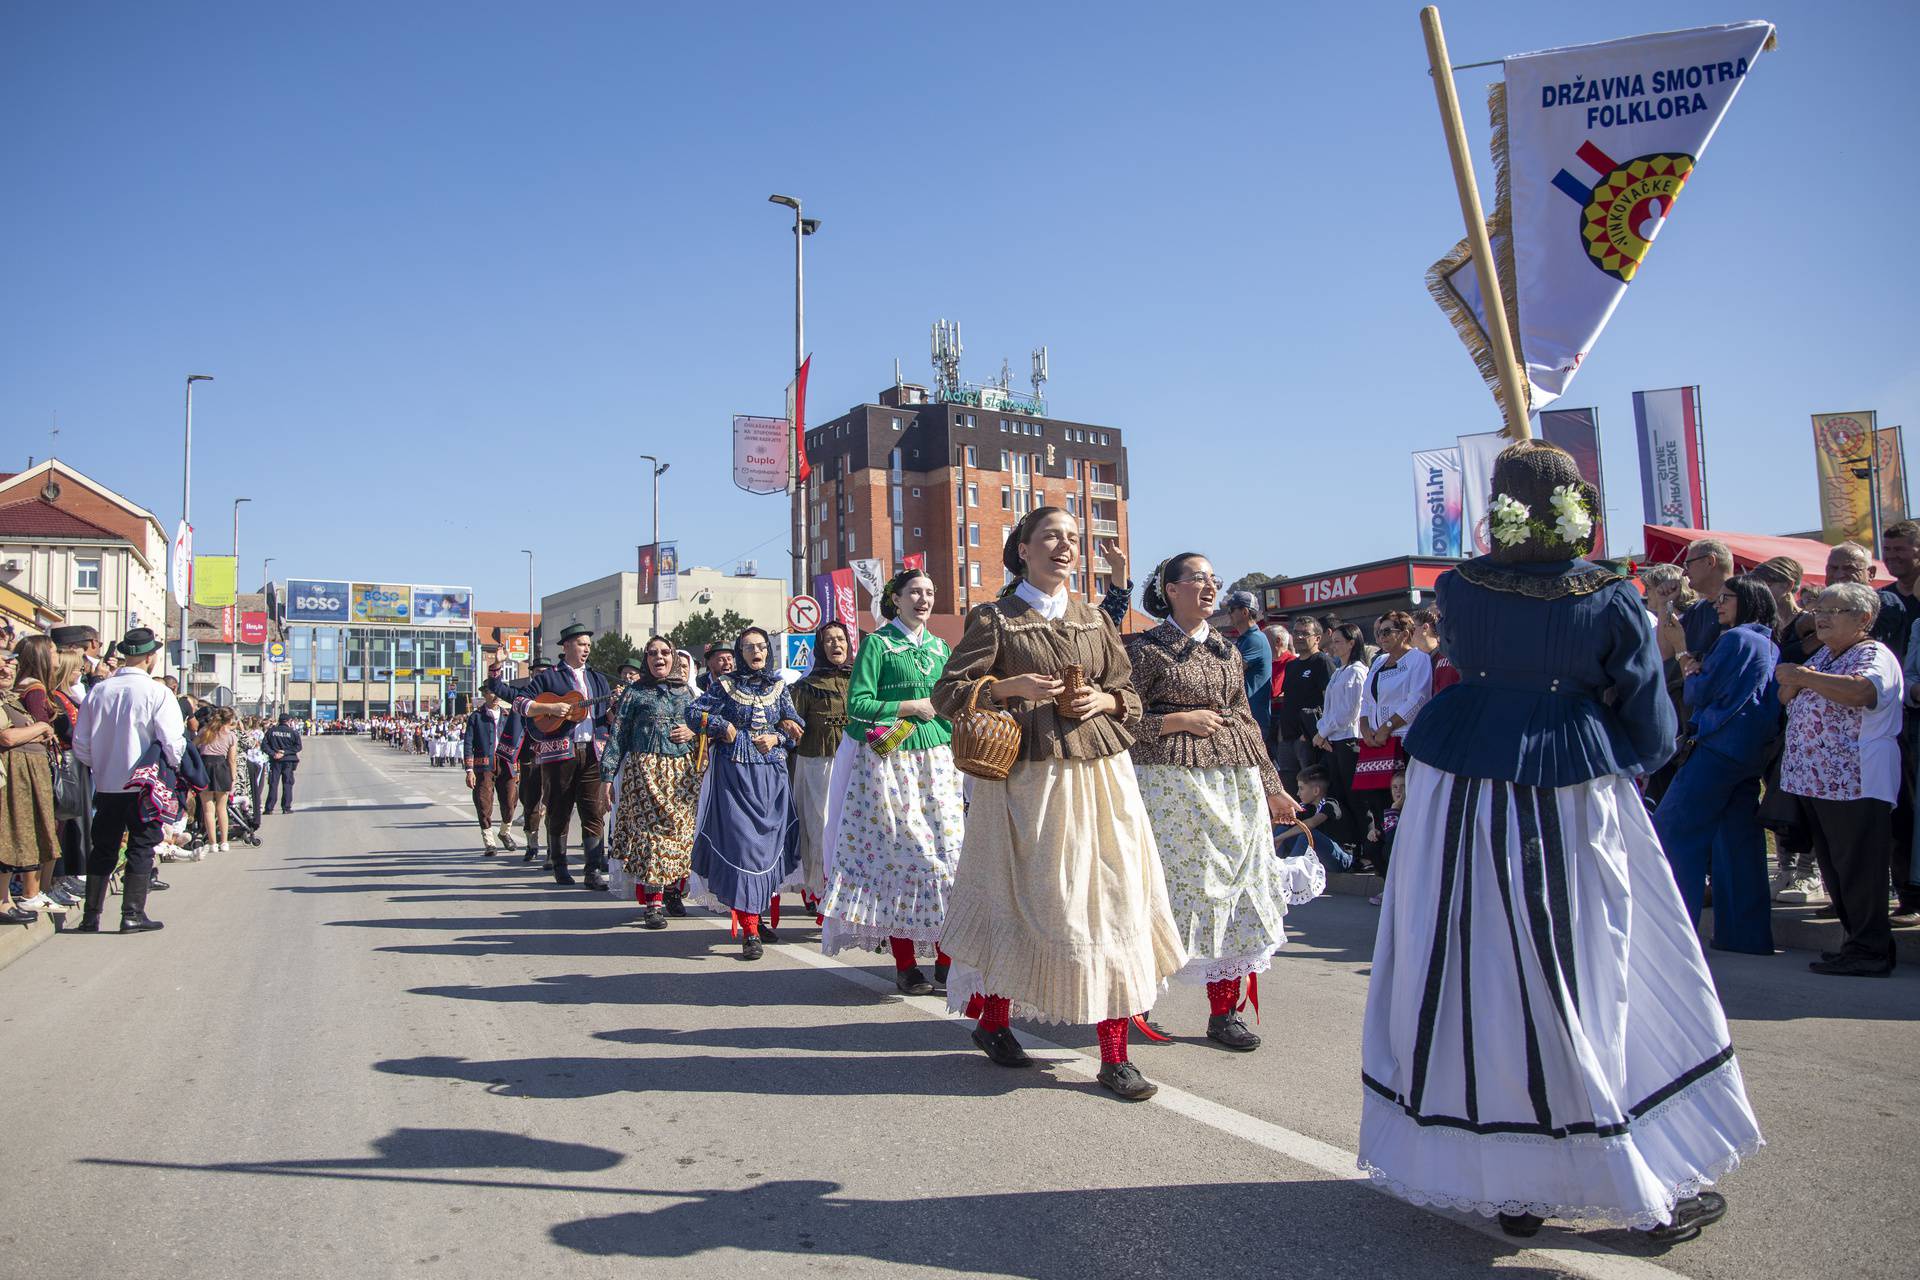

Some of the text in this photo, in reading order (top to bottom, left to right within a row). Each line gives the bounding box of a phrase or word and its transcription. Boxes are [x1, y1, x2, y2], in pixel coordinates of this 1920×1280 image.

[1541, 57, 1748, 108] DRŽAVNA SMOTRA
[1587, 92, 1707, 129] FOLKLORA
[1609, 179, 1672, 245] VINKOVAČKE
[746, 455, 776, 466] Duplo
[364, 590, 399, 602] BOSO
[1302, 574, 1358, 602] TISAK
[296, 596, 340, 611] BOSO
